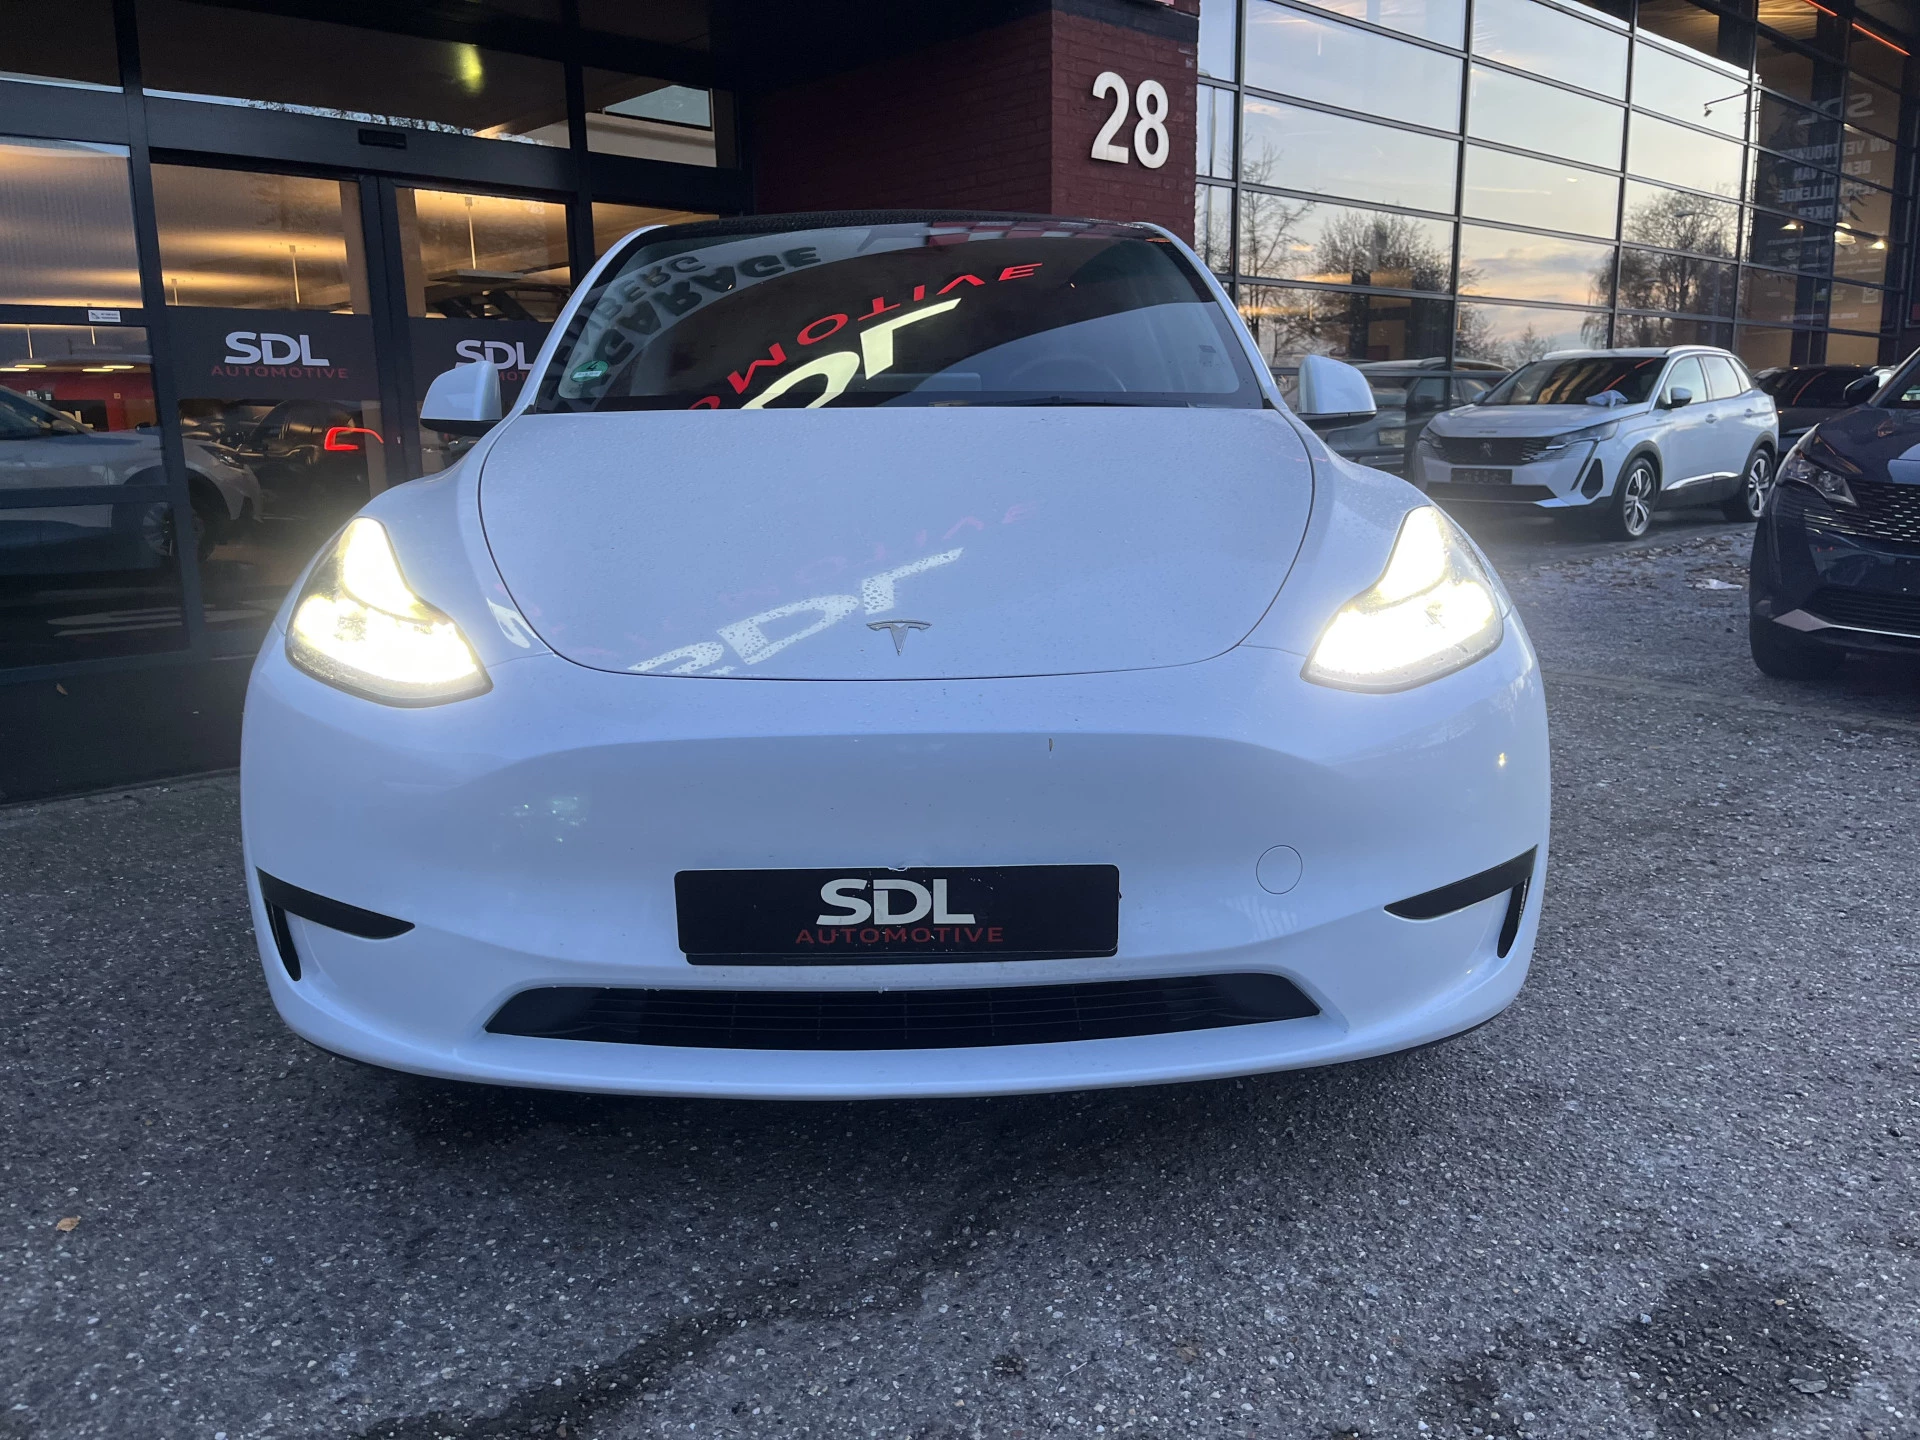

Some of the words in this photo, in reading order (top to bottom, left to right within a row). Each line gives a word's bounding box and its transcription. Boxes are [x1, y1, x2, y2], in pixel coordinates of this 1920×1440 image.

[1091, 71, 1169, 168] 28
[224, 331, 330, 367] SDL
[455, 339, 535, 371] SDL
[211, 365, 349, 380] AUTOMOTIVE
[815, 878, 976, 926] SDL
[795, 927, 1004, 944] AUTOMOTIVE
